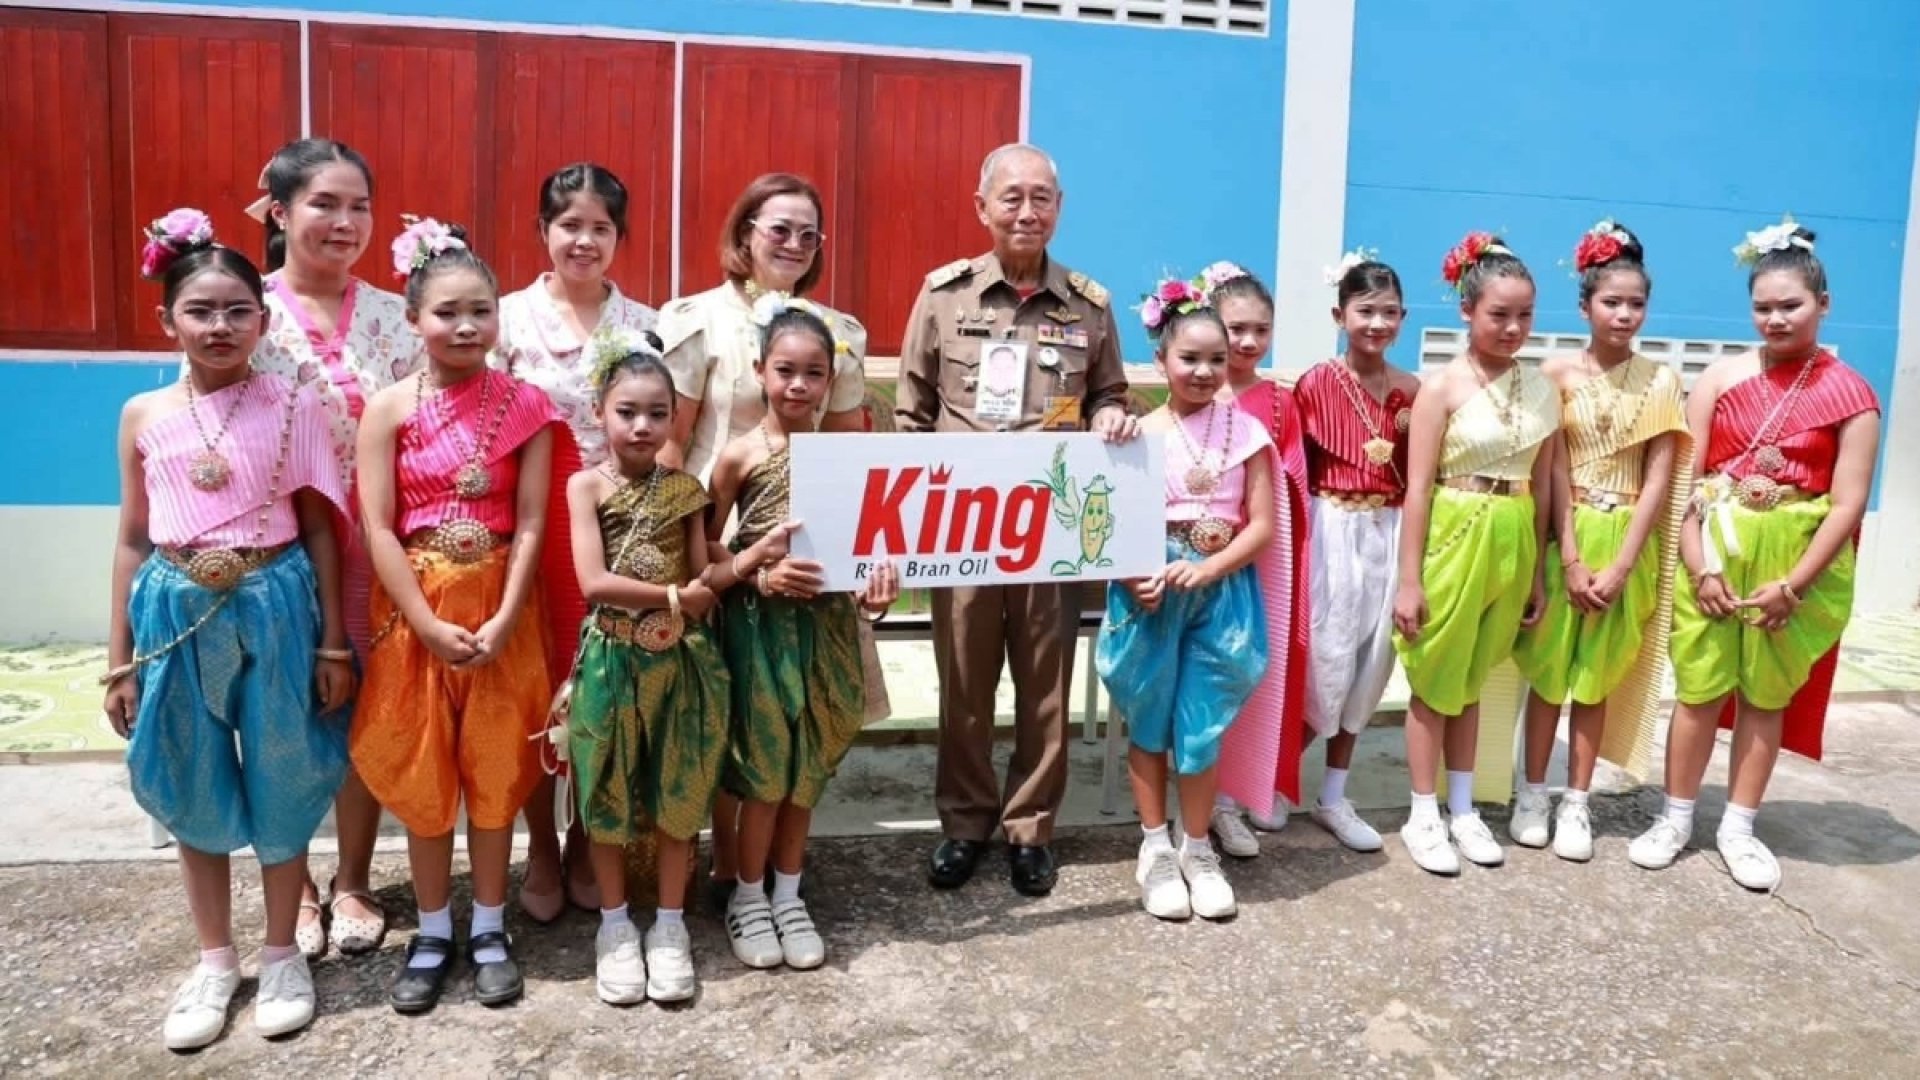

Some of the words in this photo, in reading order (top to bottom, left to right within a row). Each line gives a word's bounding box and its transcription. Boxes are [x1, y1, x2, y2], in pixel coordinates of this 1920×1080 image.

[852, 463, 1052, 573] King
[905, 561, 950, 577] Bran
[959, 557, 988, 576] Oil
